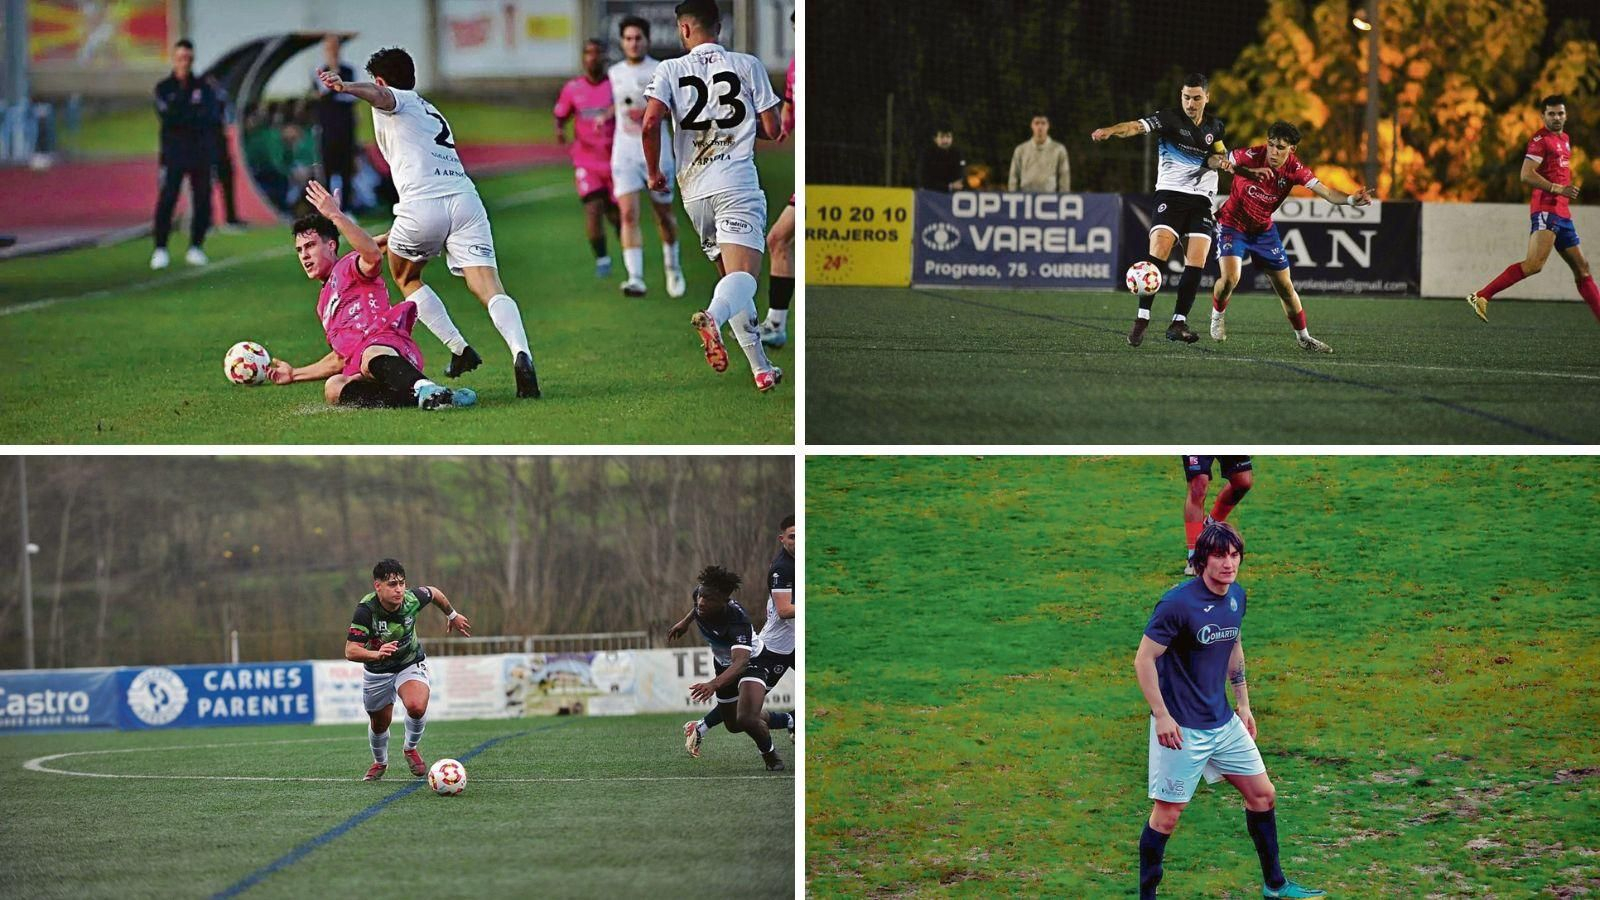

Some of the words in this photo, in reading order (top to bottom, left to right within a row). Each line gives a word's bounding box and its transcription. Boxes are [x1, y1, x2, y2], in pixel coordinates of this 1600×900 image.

[679, 71, 746, 130] 23
[817, 206, 842, 222] 10
[849, 206, 875, 222] 20
[882, 207, 907, 222] 10
[951, 191, 1084, 221] OPTICA
[968, 224, 1113, 254] VARELA
[925, 260, 1001, 279] Progreso,
[1008, 262, 1028, 278] 75
[1039, 262, 1111, 279] OURENSE
[203, 667, 302, 691] CARNES
[197, 693, 309, 718] PARENTE
